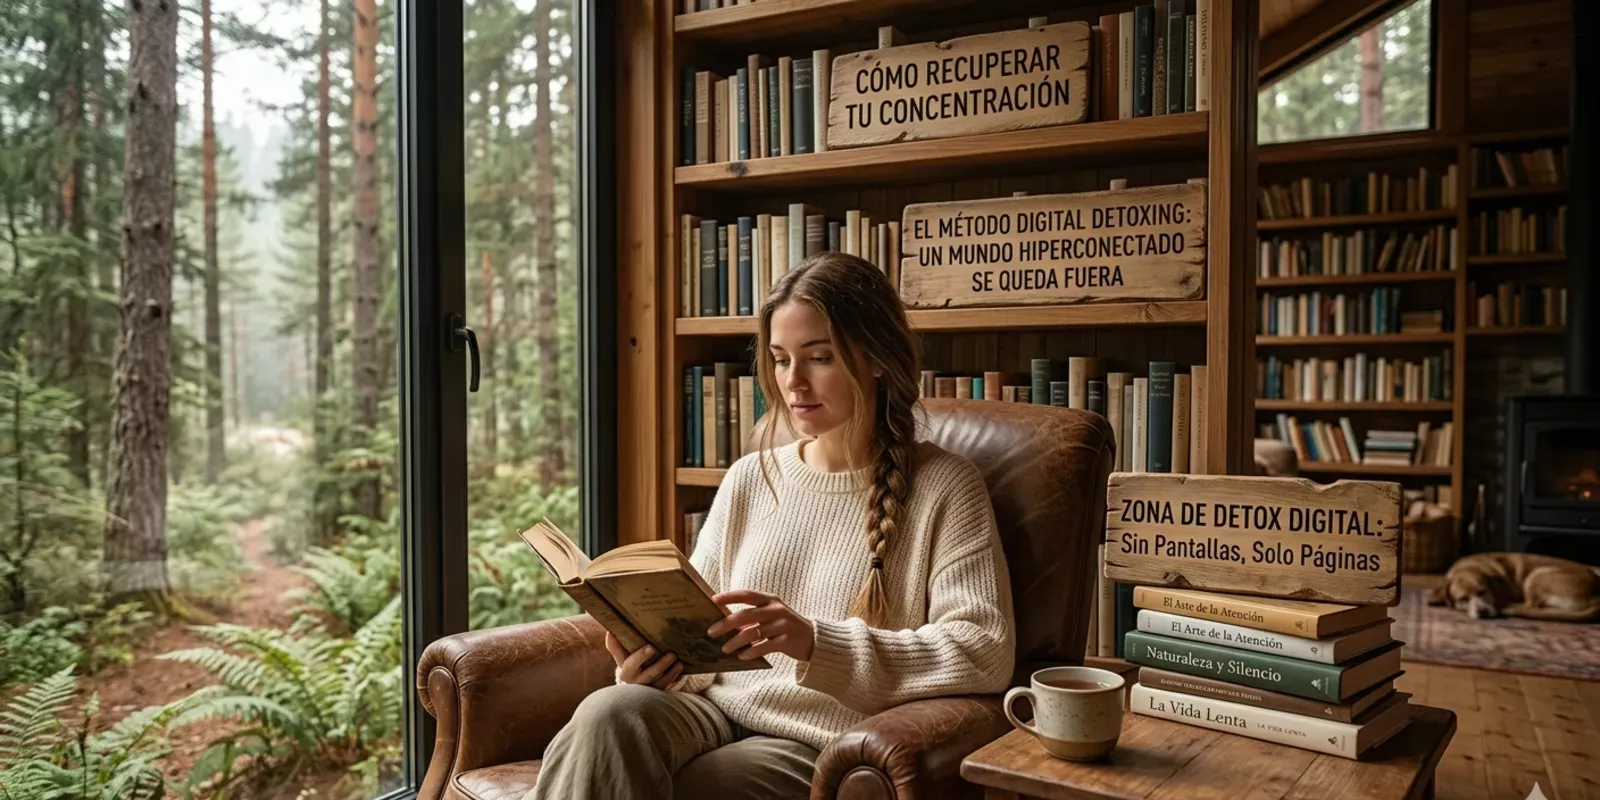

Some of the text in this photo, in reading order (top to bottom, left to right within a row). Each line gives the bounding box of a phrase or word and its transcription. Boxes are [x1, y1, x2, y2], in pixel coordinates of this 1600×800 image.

[857, 60, 919, 95] CÓMO
[926, 44, 1061, 86] RECUPERAR
[845, 75, 1070, 128] TU CONCENTRACIÓN
[914, 202, 1193, 239] EL MÉTODO DIGITAL DETOXING:
[919, 232, 1185, 267] UN MUNDO HIPERCONECTADO
[972, 266, 1124, 292] SE QUEDA FUERA
[1120, 498, 1383, 538] ZONA DE DETOX DIGITAL:
[1120, 532, 1381, 574] Sin Pantallas, Solo Páginas
[1163, 597, 1172, 608] El
[1196, 603, 1208, 613] de
[1209, 604, 1219, 615] la
[1171, 622, 1283, 650] El Arte de la Atención
[1146, 645, 1213, 670] Naturaleza
[1216, 661, 1225, 674] y
[1227, 660, 1282, 683] Silencio
[1149, 696, 1247, 729] La Vida Lenta
